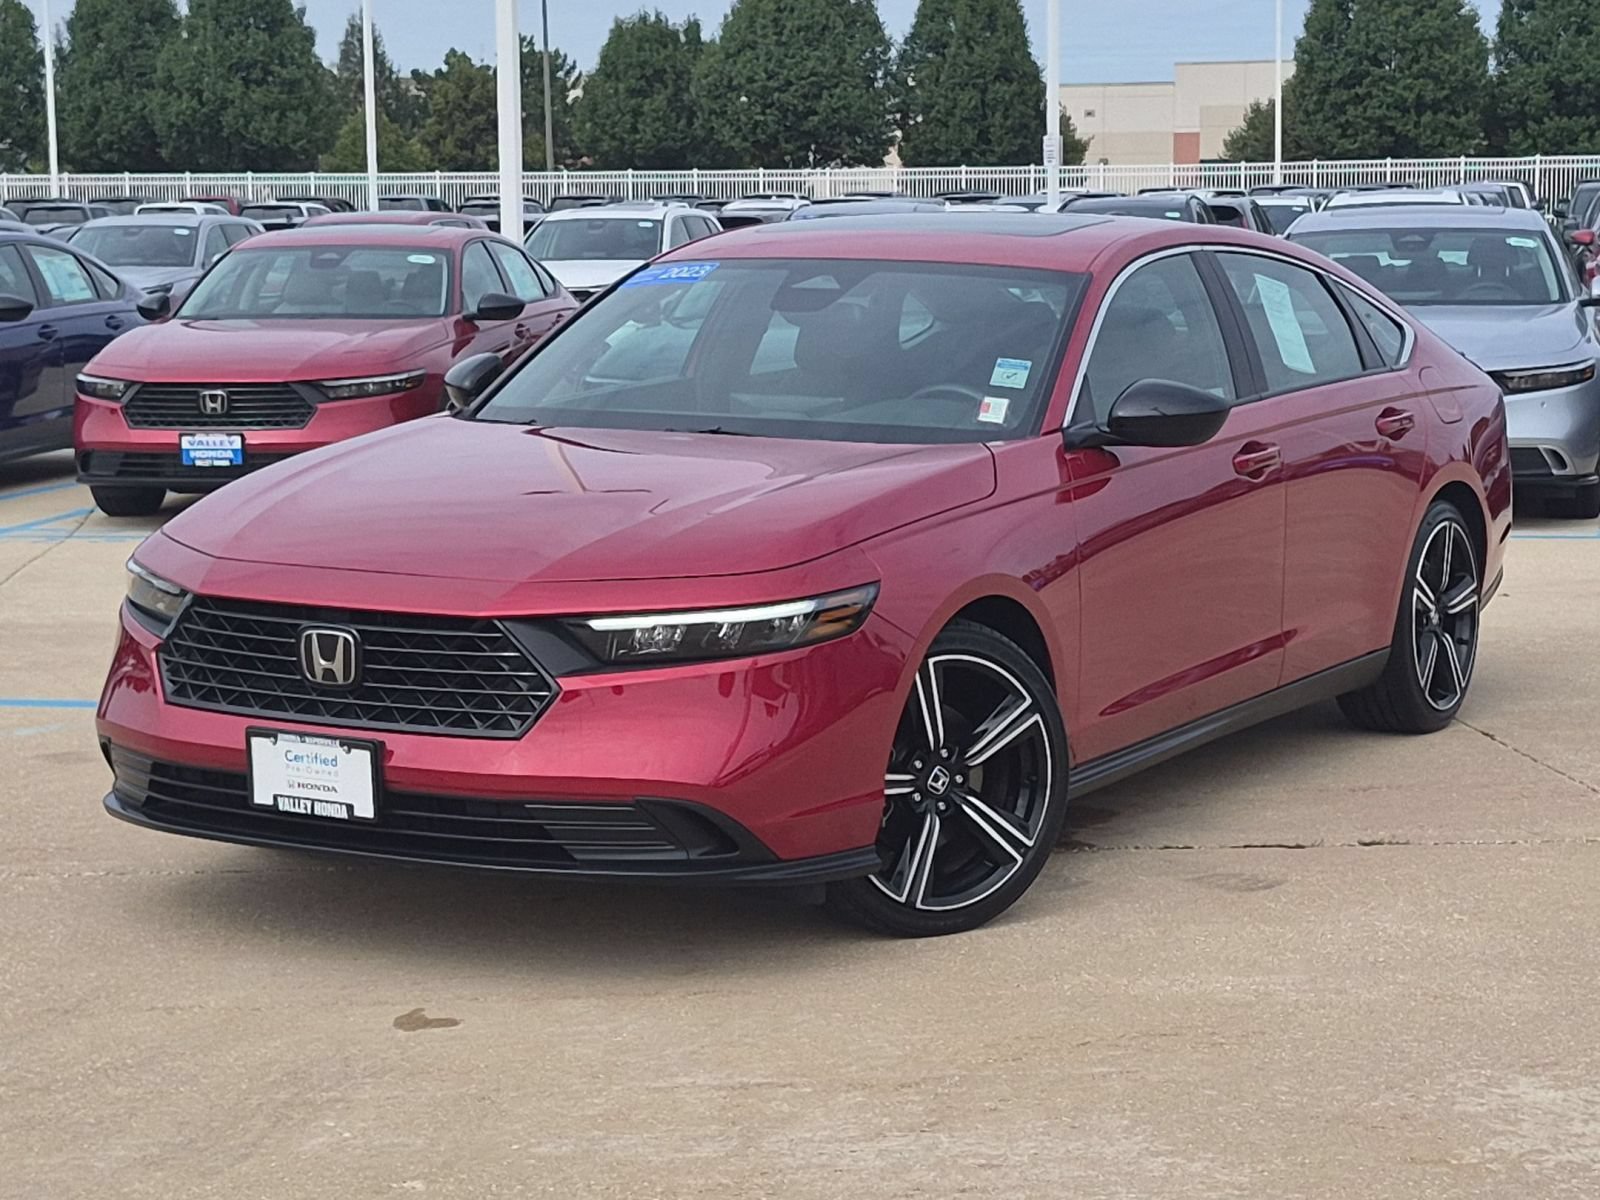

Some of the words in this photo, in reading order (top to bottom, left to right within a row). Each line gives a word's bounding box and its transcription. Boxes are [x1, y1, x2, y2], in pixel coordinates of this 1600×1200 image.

[187, 439, 235, 447] VALLEY
[189, 449, 235, 459] HONDA
[285, 750, 338, 767] Certified
[297, 782, 338, 793] HONDA
[277, 796, 312, 815] VALLEY
[313, 801, 348, 819] HONDA
